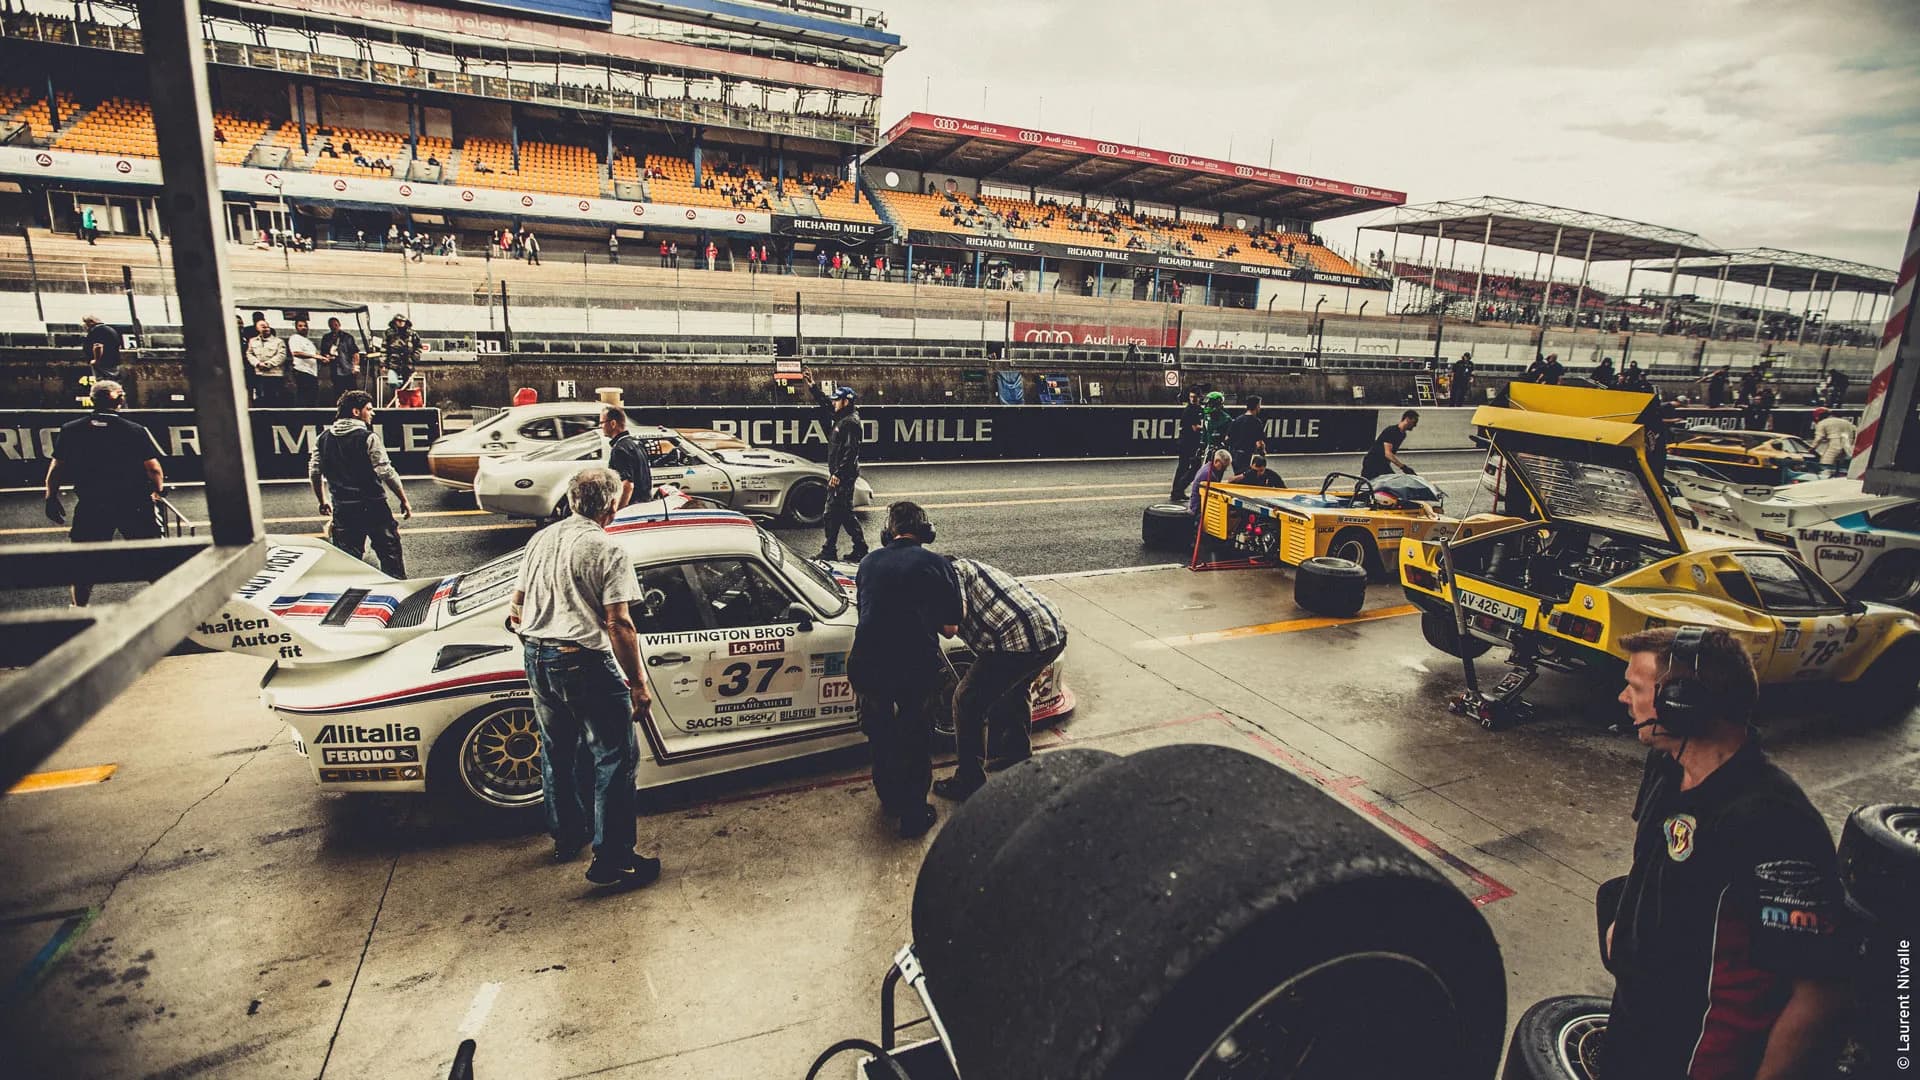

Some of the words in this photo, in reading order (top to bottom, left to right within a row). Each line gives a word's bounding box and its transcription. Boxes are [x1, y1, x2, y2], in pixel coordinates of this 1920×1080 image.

[962, 122, 980, 131] Audi
[1045, 135, 1061, 144] Audi
[1121, 147, 1136, 155] Audi
[793, 219, 841, 232] RICHARD
[843, 223, 875, 235] MILLE
[965, 236, 1006, 248] RICHARD
[1008, 240, 1035, 251] MILLE
[1067, 247, 1103, 258] RICHARD
[1104, 250, 1129, 261] MILLE
[1158, 256, 1191, 267] RICHARD
[1192, 259, 1215, 269] MILLE
[1240, 265, 1270, 275] RICHARD
[1271, 268, 1292, 277] MILLE
[1313, 272, 1341, 282] RICHARD
[1342, 275, 1360, 285] MILLE
[1083, 334, 1113, 345] Audi
[1117, 335, 1147, 346] ultra
[272, 423, 430, 455] MLE
[712, 419, 879, 446] RICHAD
[895, 419, 993, 443] MILLE
[1288, 516, 1304, 525] LUCAS
[1854, 533, 1886, 548] Dinol
[264, 549, 304, 573] MOLY
[232, 632, 292, 648] Autos
[646, 629, 750, 646] WHITTINGTON
[755, 626, 795, 639] BROS
[279, 645, 303, 659] fit
[734, 643, 748, 654] Le
[750, 640, 781, 652] Point
[718, 657, 785, 697] 37
[823, 682, 850, 698] GT2
[739, 713, 767, 722] BOSCH
[780, 708, 816, 721] BILSTEIN
[686, 716, 733, 730] SACHS
[313, 723, 421, 745] Alitalia
[326, 749, 396, 763] FERODO
